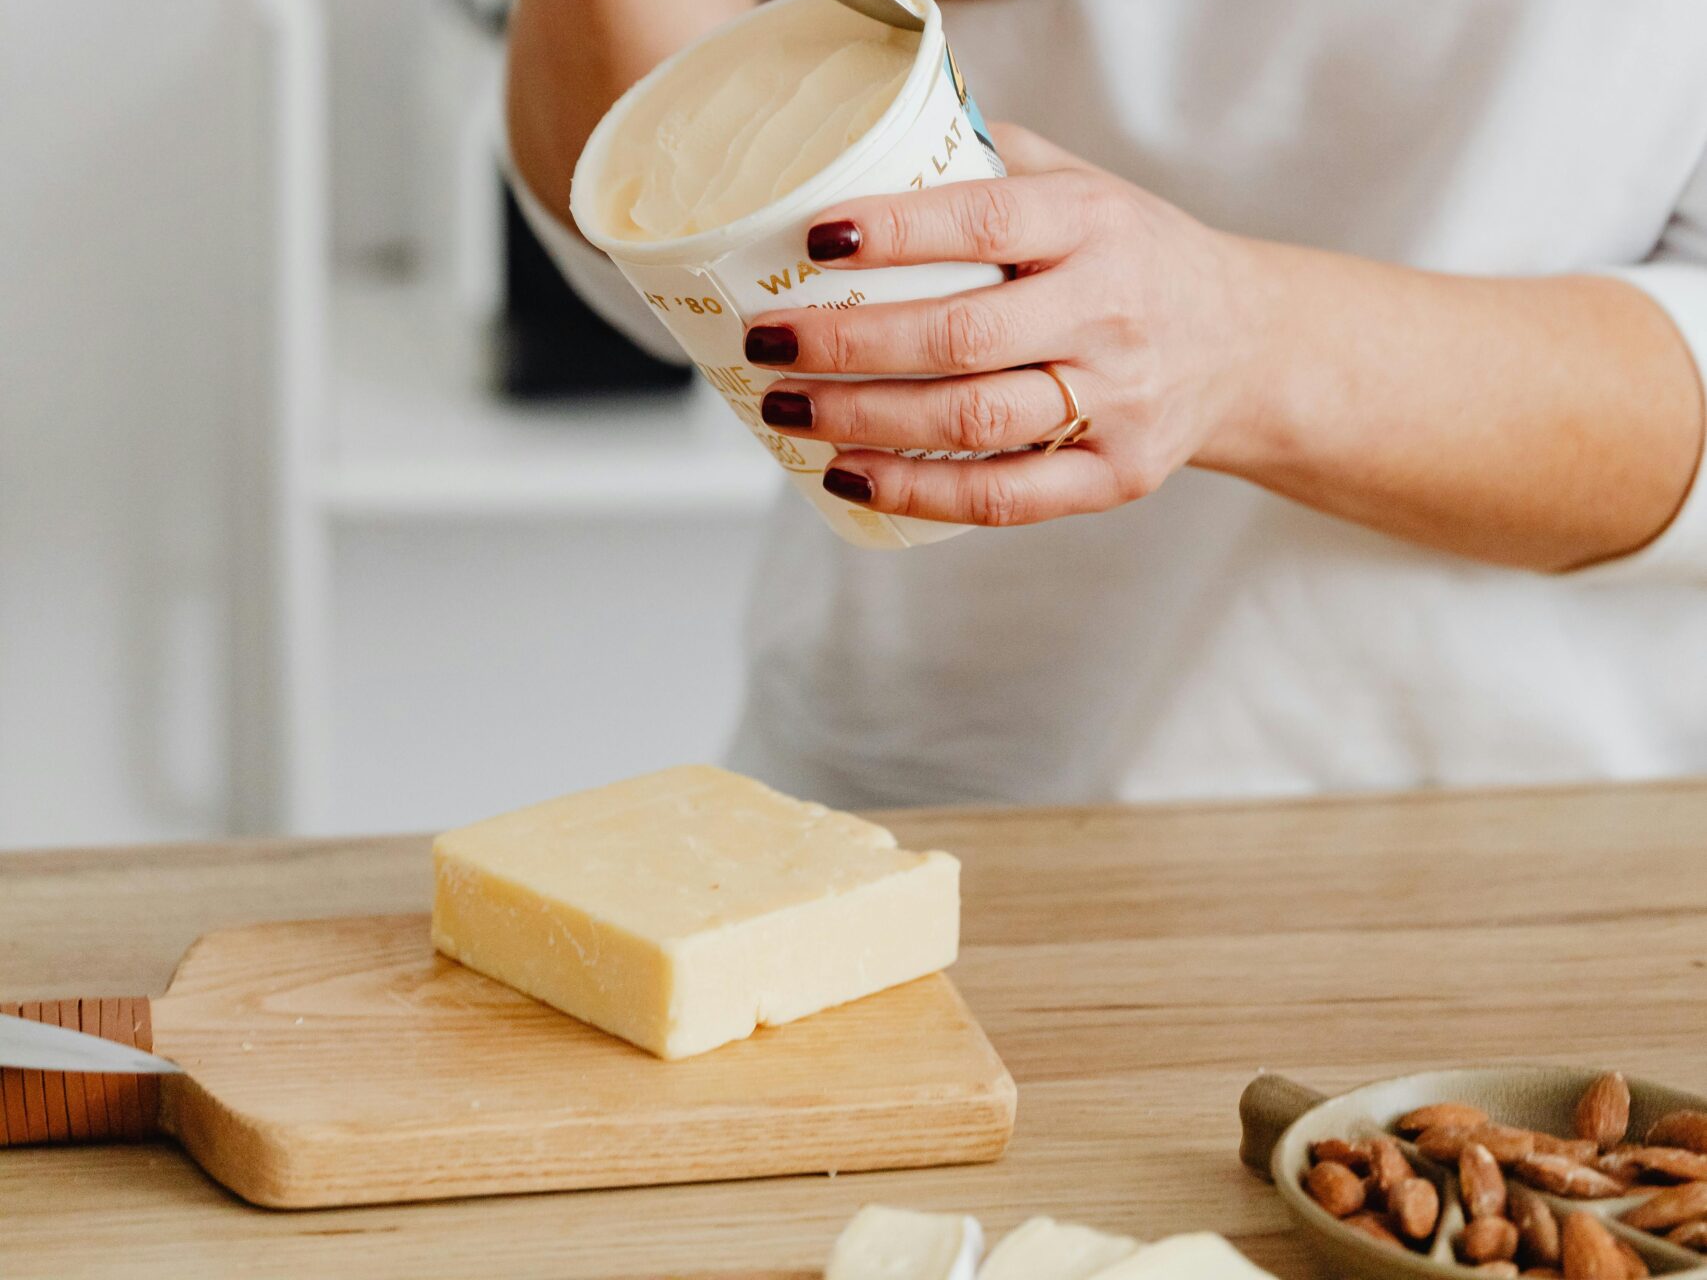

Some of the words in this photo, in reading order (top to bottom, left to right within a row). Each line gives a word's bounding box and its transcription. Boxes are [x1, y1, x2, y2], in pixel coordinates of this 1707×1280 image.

[932, 117, 962, 176] LAT
[756, 260, 821, 296] WA
[674, 296, 723, 315] '80
